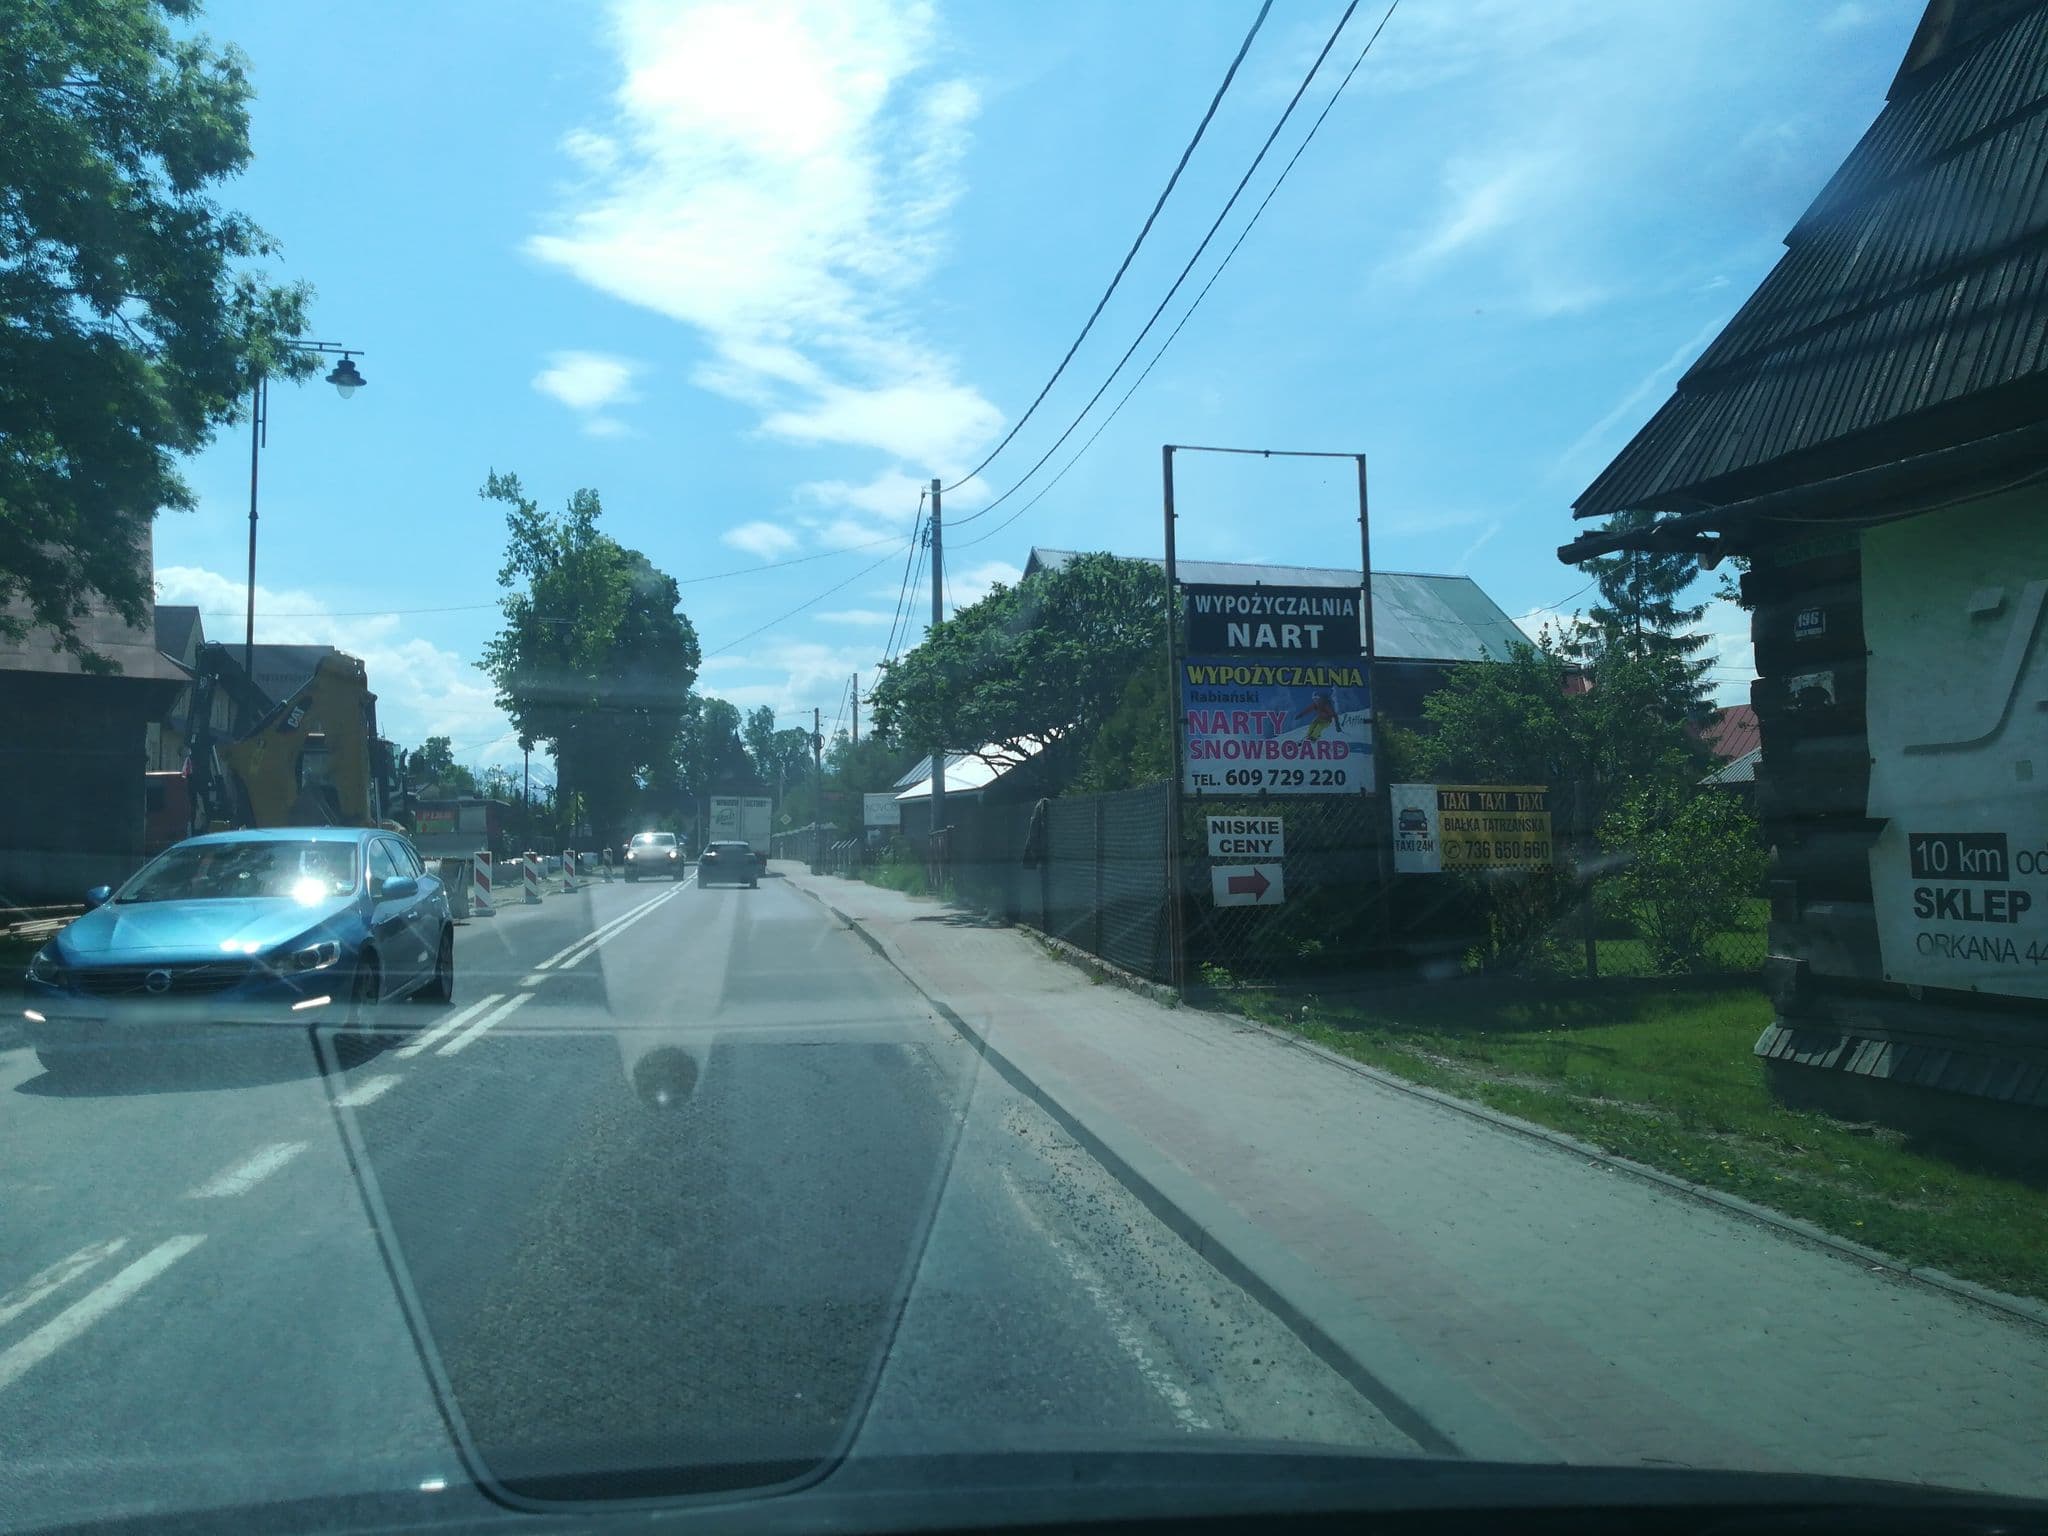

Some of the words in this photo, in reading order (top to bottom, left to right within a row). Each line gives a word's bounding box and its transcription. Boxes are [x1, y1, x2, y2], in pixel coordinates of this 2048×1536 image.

[1195, 592, 1354, 617] WYPOŻYCZALNIA
[1227, 622, 1324, 649] NART
[1187, 664, 1364, 687] WYPOŻYCZALNIA
[1190, 690, 1259, 704] Rabiański
[288, 706, 305, 728] CAT
[1187, 710, 1288, 735] NARTY
[1189, 740, 1350, 760] SNOWBOARD
[1192, 774, 1221, 786] TEL.
[1225, 769, 1263, 786] 609
[1268, 769, 1304, 786] 729
[1310, 769, 1346, 786] 220
[1441, 792, 1470, 810] TAXI
[1478, 793, 1507, 810] TAXI
[1515, 793, 1544, 811] TAXI
[1212, 820, 1280, 834] NISKIE
[1444, 818, 1480, 832] BIAŁKA
[1482, 815, 1545, 833] TATRZAŃSKA
[1219, 839, 1274, 853] CENY
[1395, 839, 1415, 852] TAXI
[1416, 840, 1434, 853] 24H
[1465, 840, 1490, 859] 736
[1495, 841, 1521, 860] 650
[1523, 841, 1549, 860] 560
[1917, 840, 1949, 872] 10
[1959, 840, 2002, 873] km
[1913, 886, 2032, 924] SKLEP
[1916, 932, 2020, 965] ORKANA
